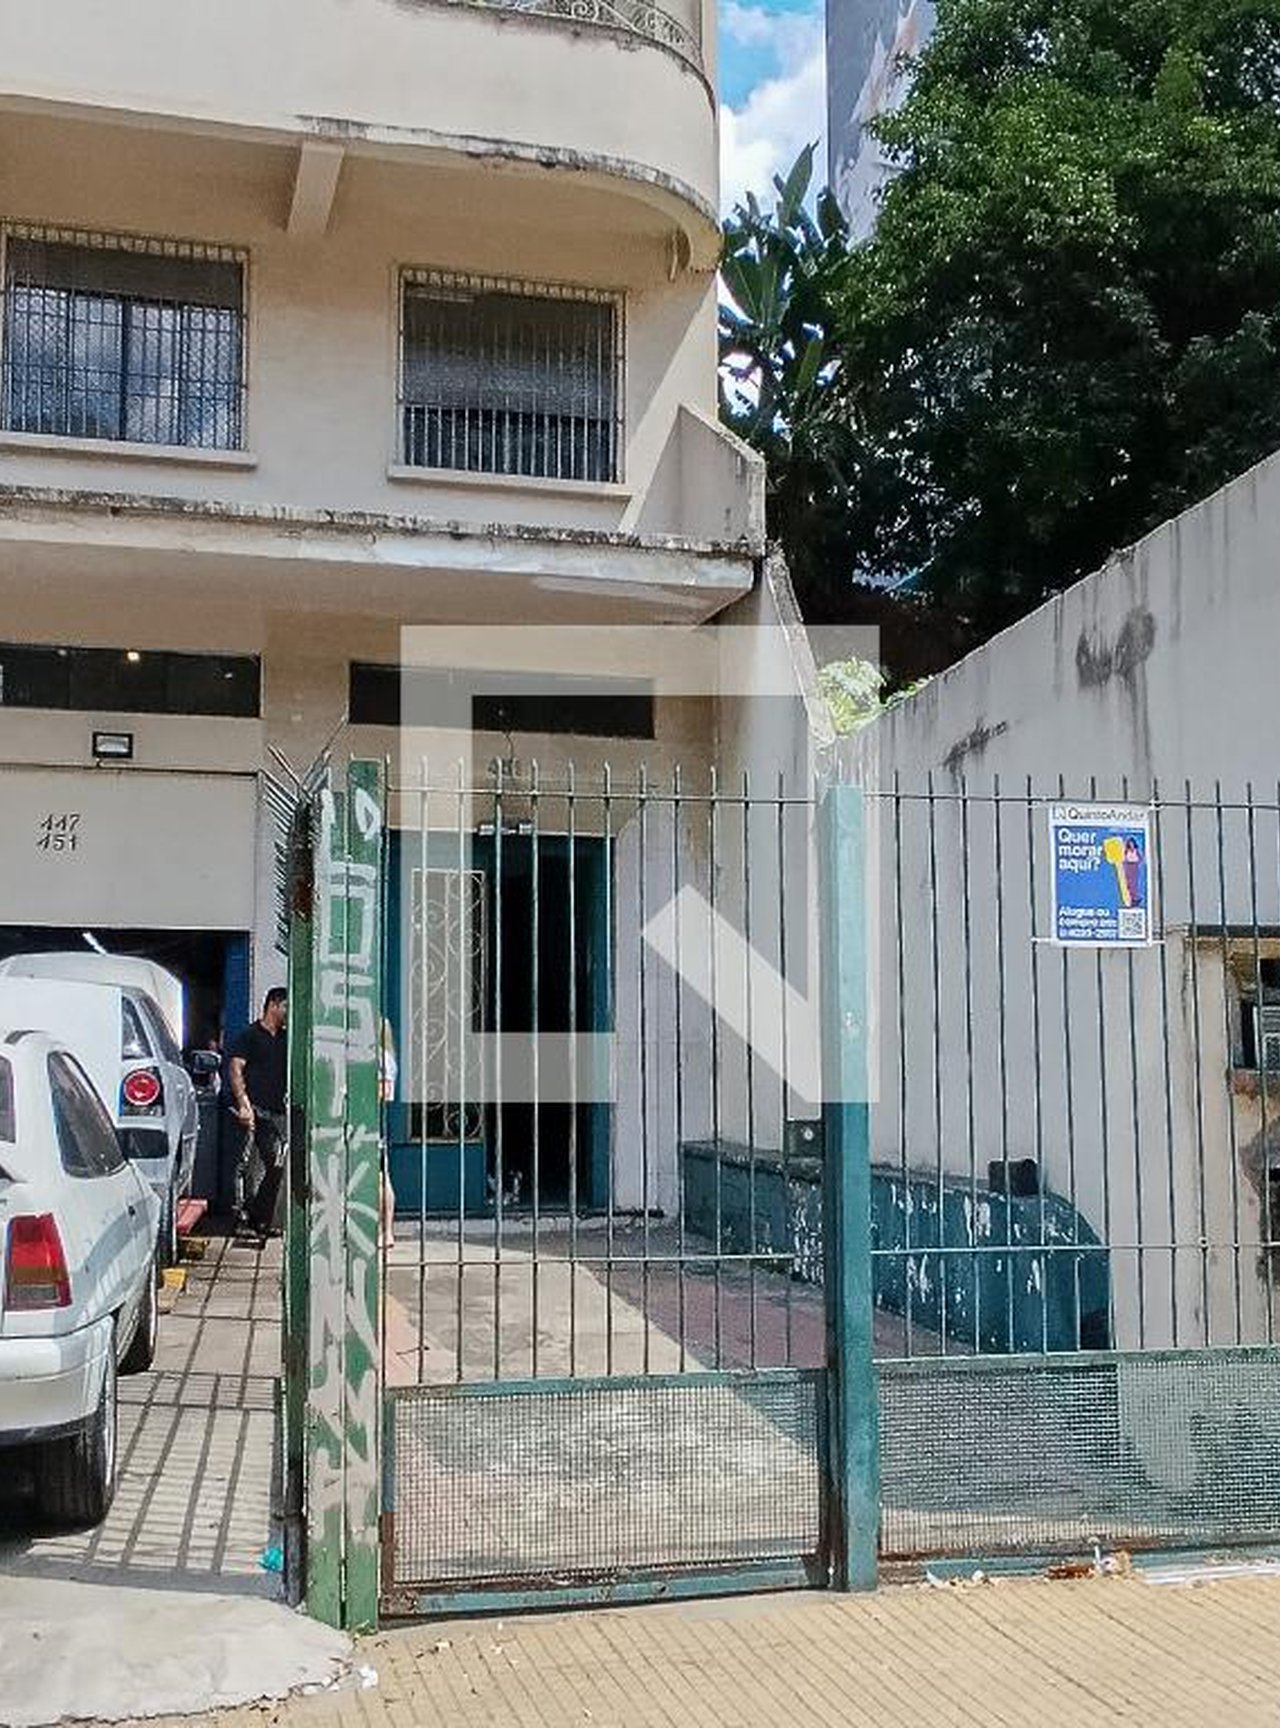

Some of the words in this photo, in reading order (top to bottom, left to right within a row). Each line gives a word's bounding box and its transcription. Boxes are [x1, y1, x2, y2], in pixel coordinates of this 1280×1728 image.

[1058, 828, 1097, 844] Quer
[1058, 845, 1103, 857] morar
[1058, 858, 1101, 874] aqui?
